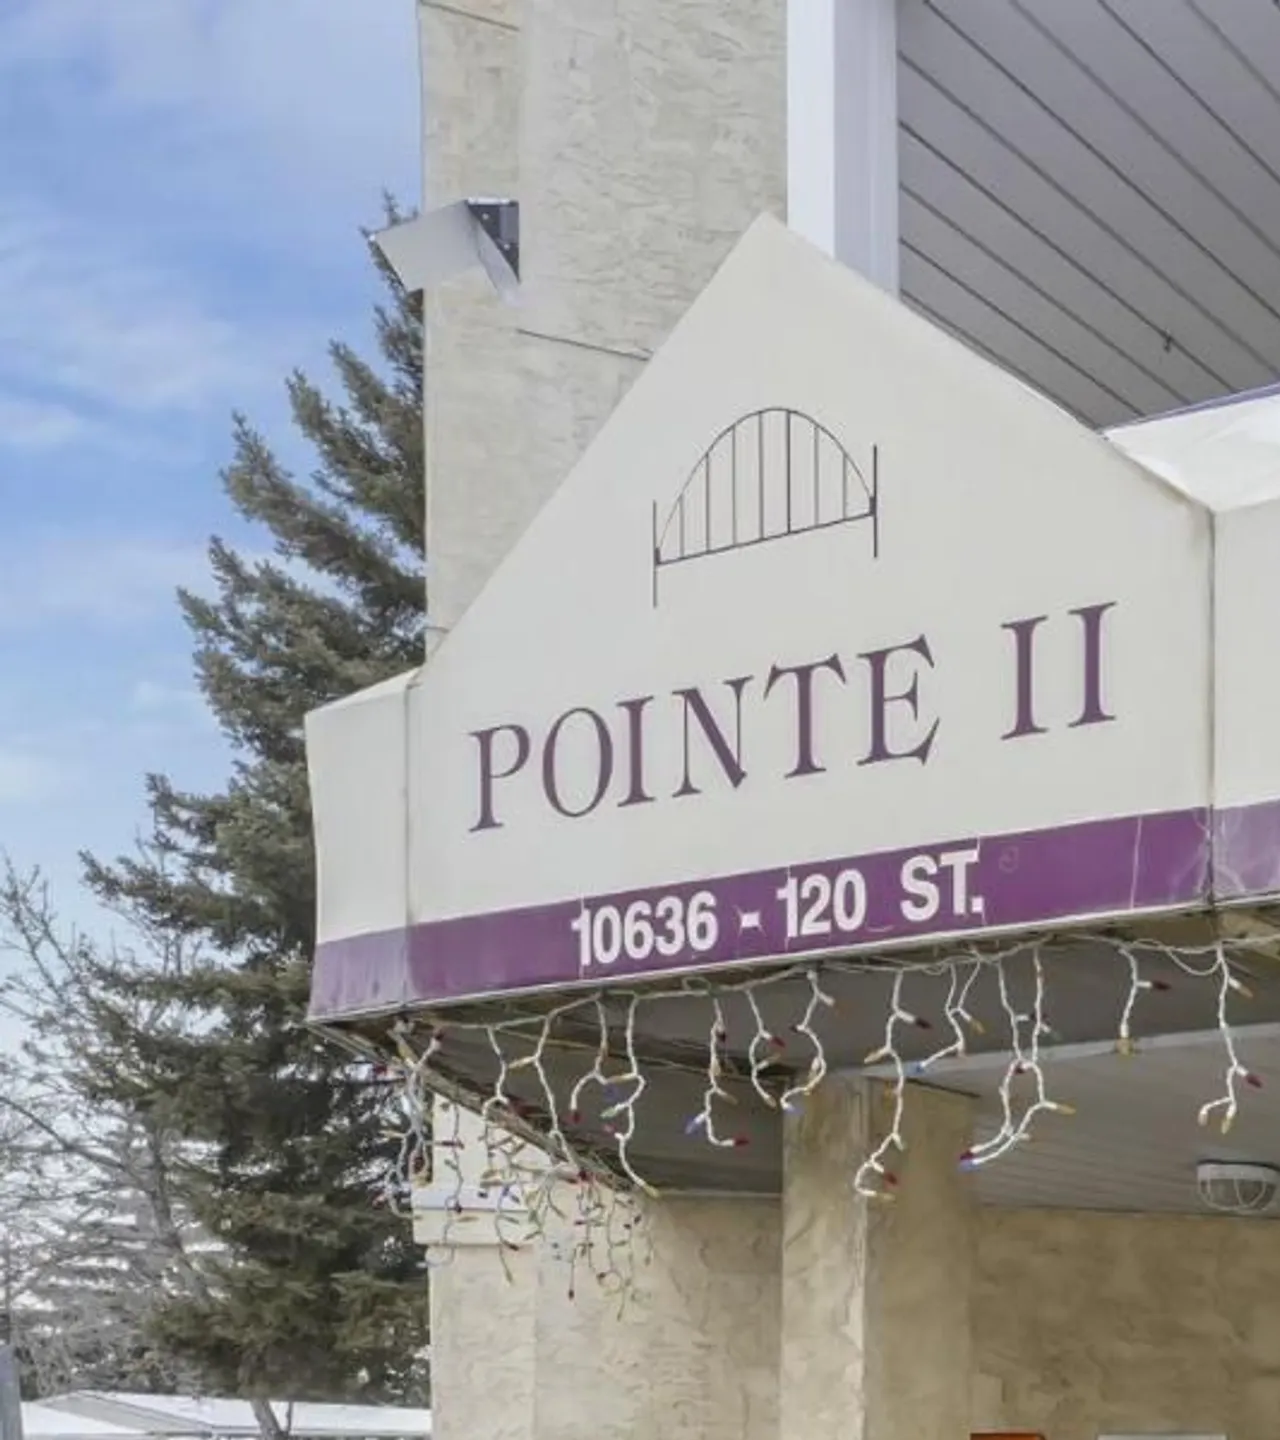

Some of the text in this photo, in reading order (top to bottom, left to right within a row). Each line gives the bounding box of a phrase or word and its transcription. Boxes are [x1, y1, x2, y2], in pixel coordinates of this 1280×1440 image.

[468, 601, 1118, 833] POINTE II
[571, 891, 719, 967] 10636
[776, 868, 867, 938] 120
[900, 848, 985, 922] ST.
